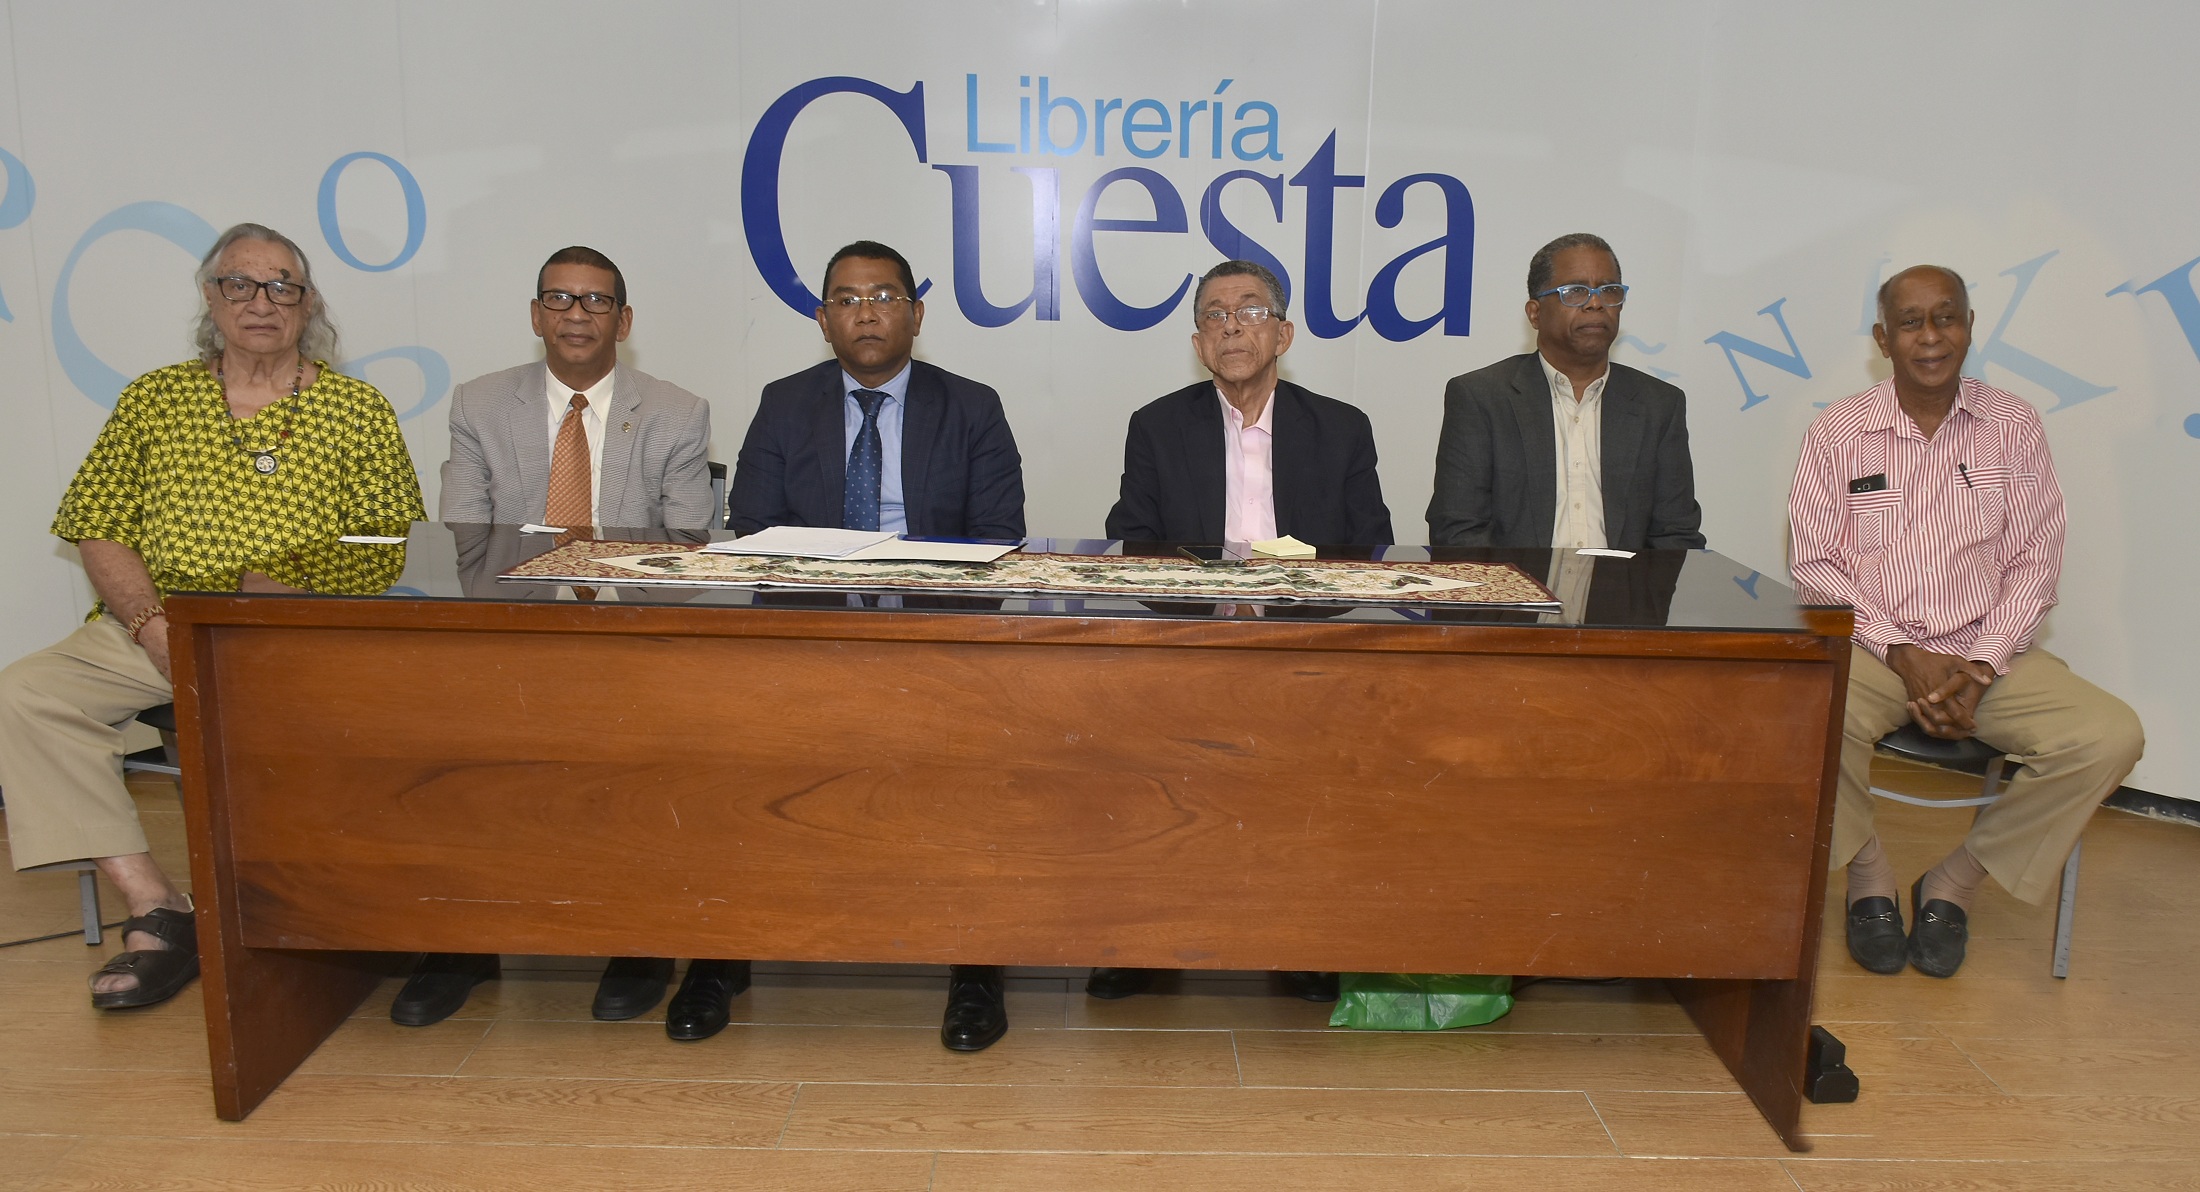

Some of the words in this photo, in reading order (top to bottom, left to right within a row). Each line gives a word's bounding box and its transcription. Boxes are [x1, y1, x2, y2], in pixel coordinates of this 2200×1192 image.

[966, 73, 1284, 162] Librería
[741, 75, 1475, 342] Cuesta
[1704, 297, 1812, 412] N
